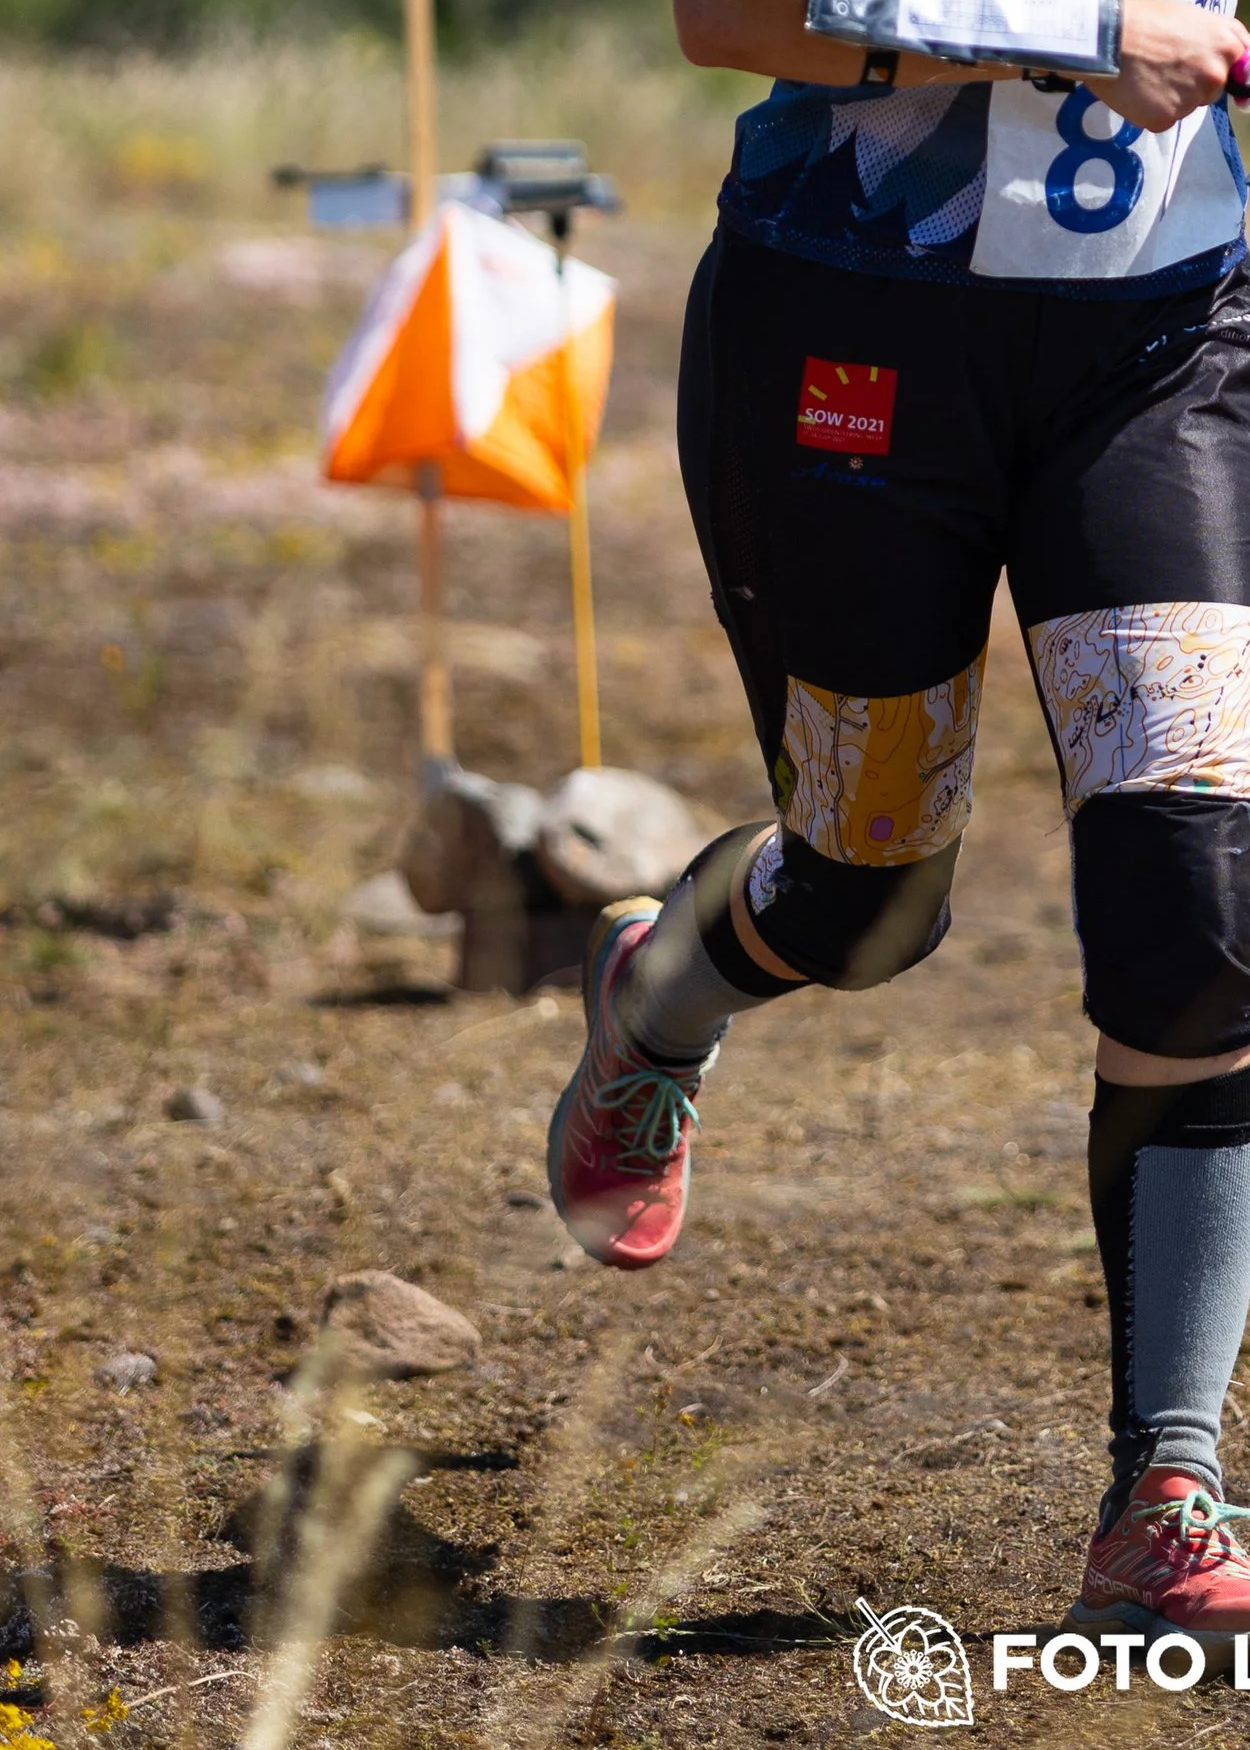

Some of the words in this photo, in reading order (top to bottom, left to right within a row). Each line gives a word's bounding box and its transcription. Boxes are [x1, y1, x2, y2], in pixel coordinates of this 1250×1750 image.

[1045, 84, 1144, 234] 8
[805, 408, 844, 426] SOW
[847, 415, 885, 432] 2021
